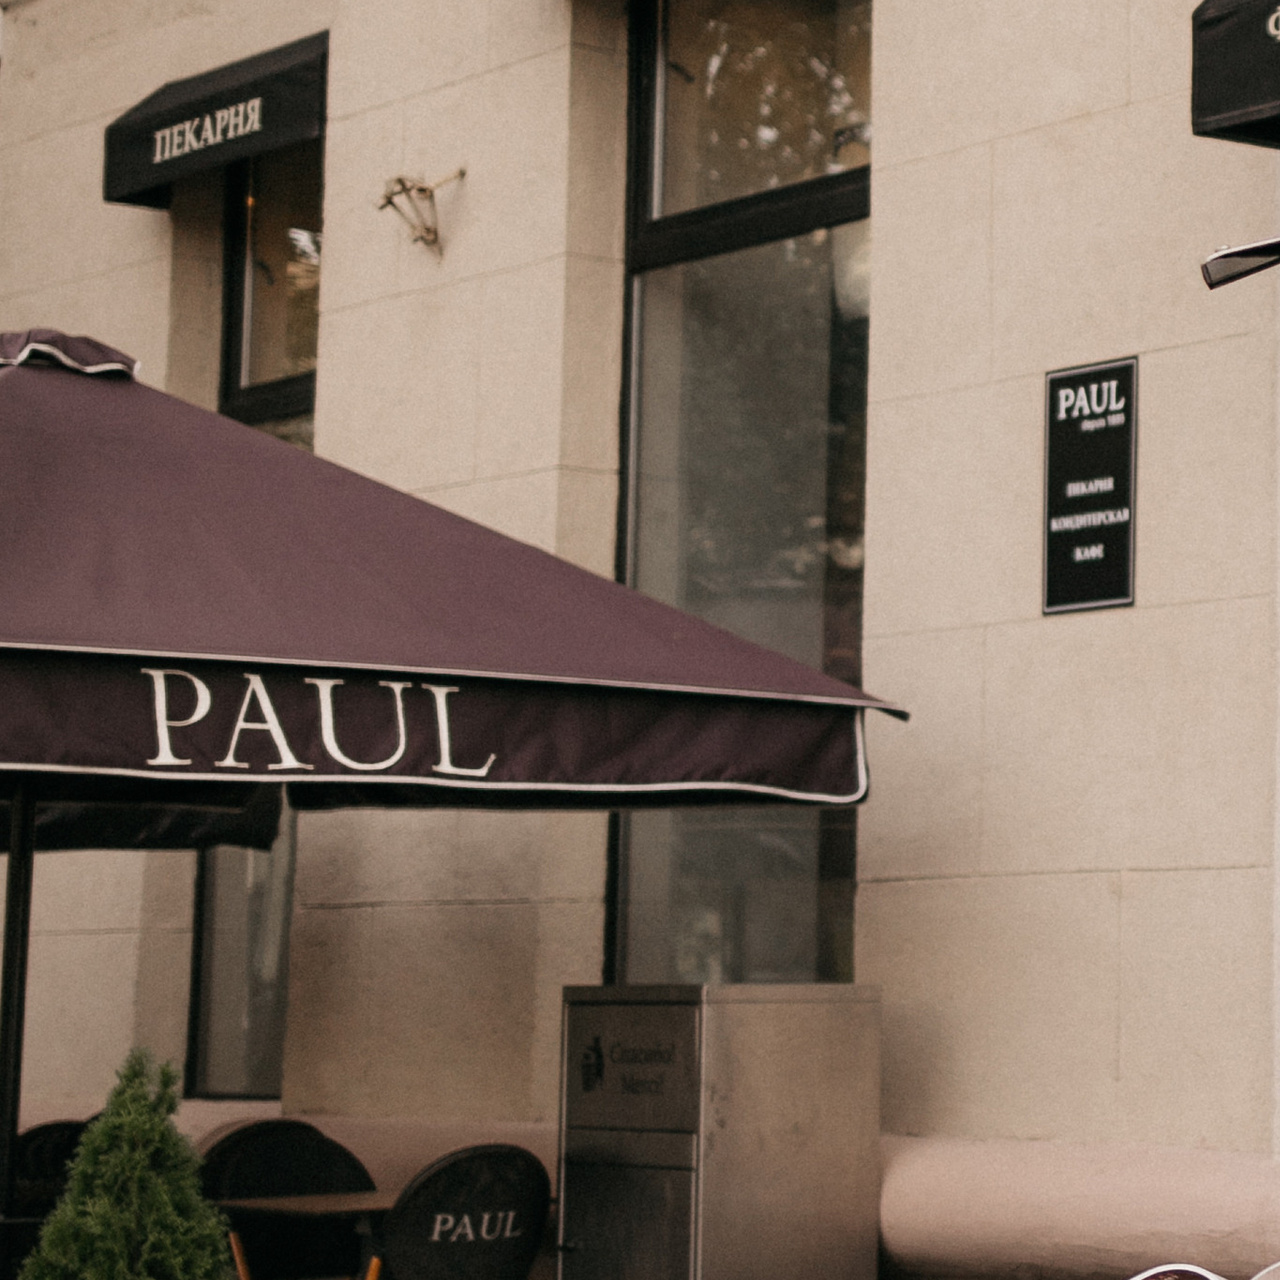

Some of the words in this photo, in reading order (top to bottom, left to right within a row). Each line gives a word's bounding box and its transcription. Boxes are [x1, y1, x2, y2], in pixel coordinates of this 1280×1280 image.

[152, 97, 263, 164] ПЕКАРНЯ
[1057, 380, 1126, 421] PAUL
[140, 668, 497, 777] PAUL
[429, 1210, 522, 1242] PAUL
